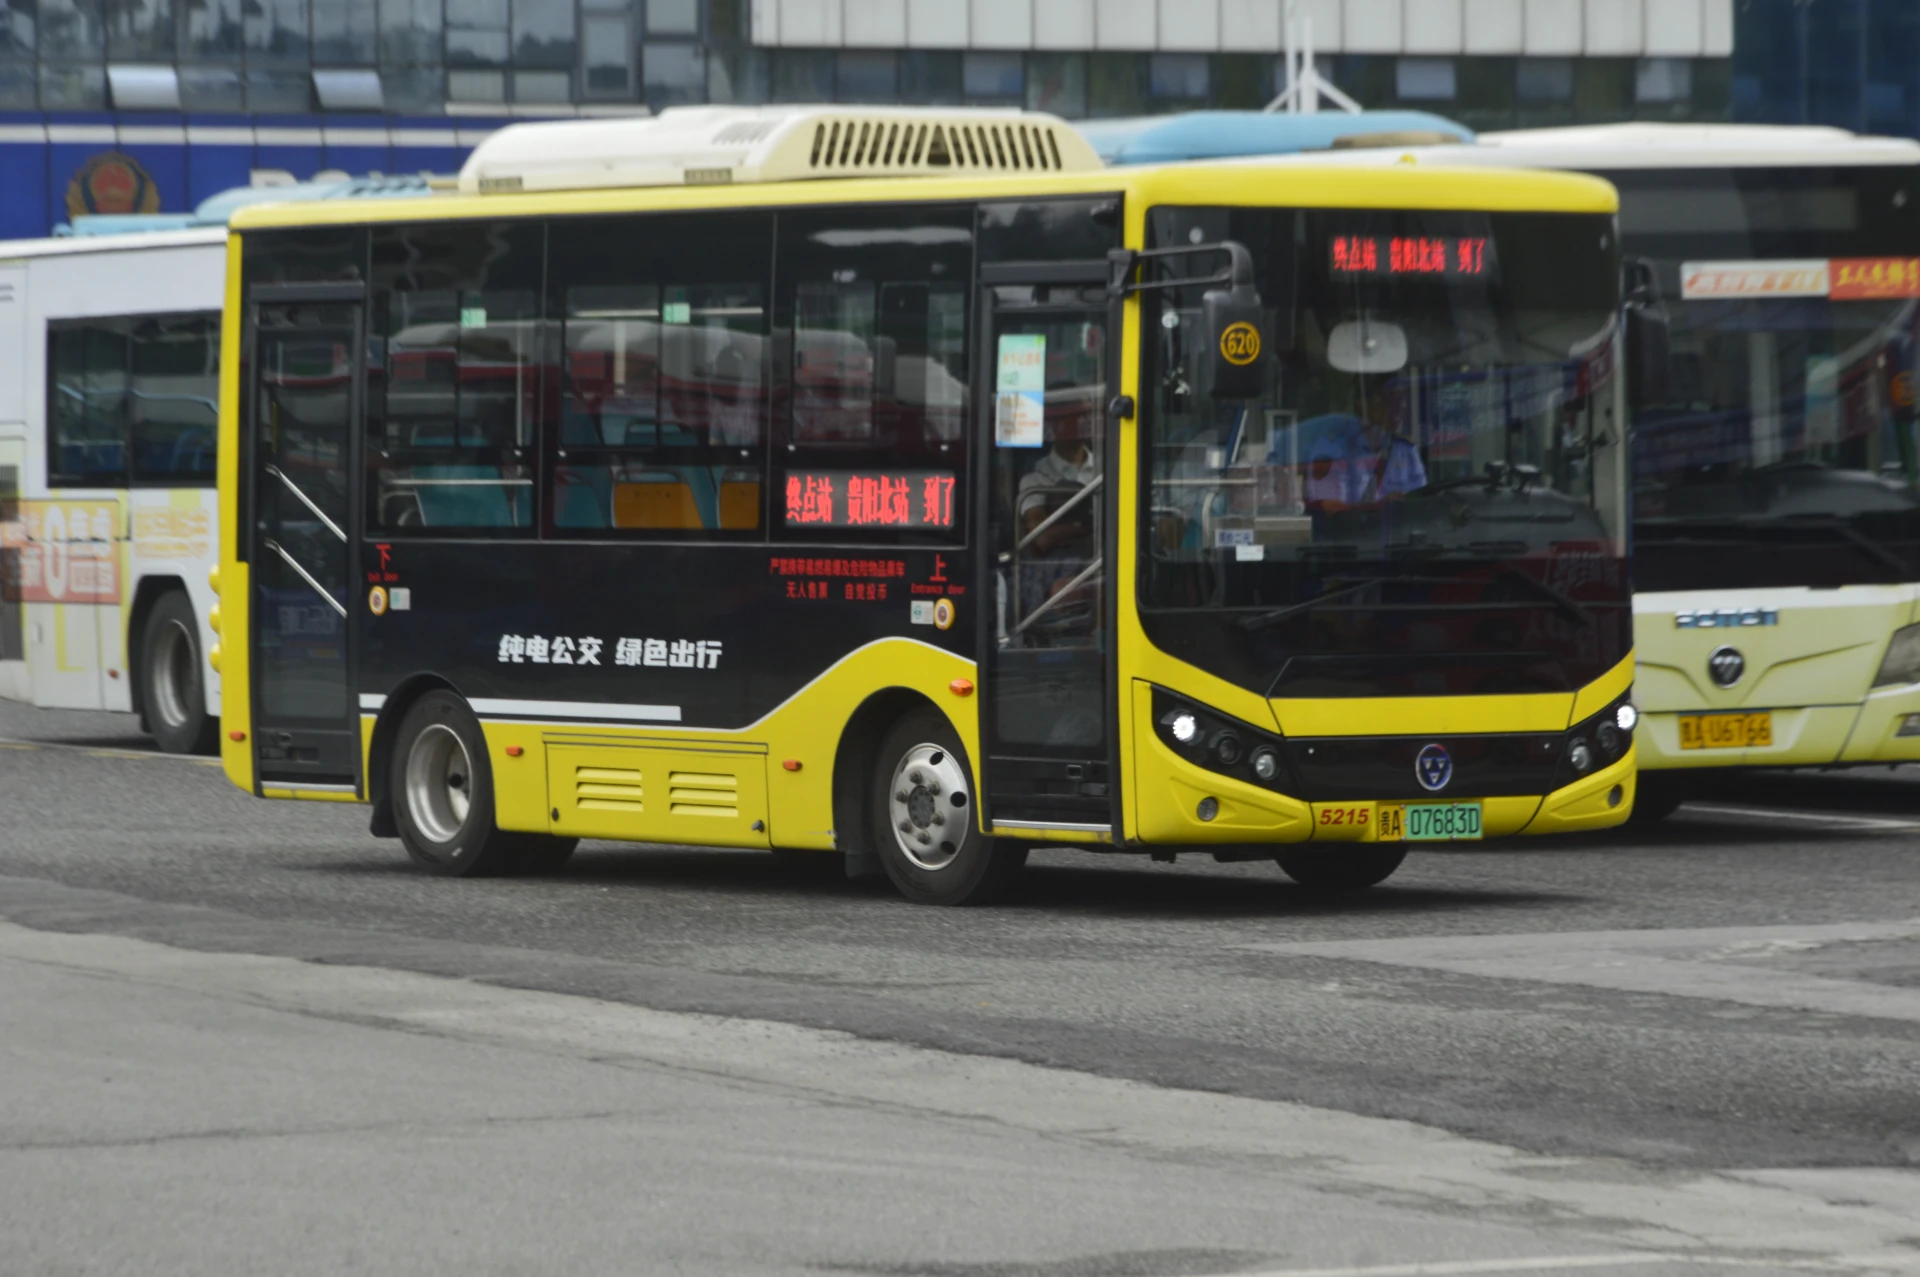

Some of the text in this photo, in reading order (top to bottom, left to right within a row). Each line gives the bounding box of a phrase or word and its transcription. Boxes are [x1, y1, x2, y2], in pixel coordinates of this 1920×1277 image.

[1333, 235, 1485, 275] 终点站 贵阳北站 到了
[1227, 332, 1255, 356] 620
[786, 475, 956, 526] 终点站 贵阳北站 到了
[375, 544, 392, 570] 下
[929, 554, 947, 582] 上
[786, 581, 887, 600] 无人售票 自觉投币
[498, 634, 722, 669] 纯电公交 绿色出行
[1320, 808, 1369, 825] 5215
